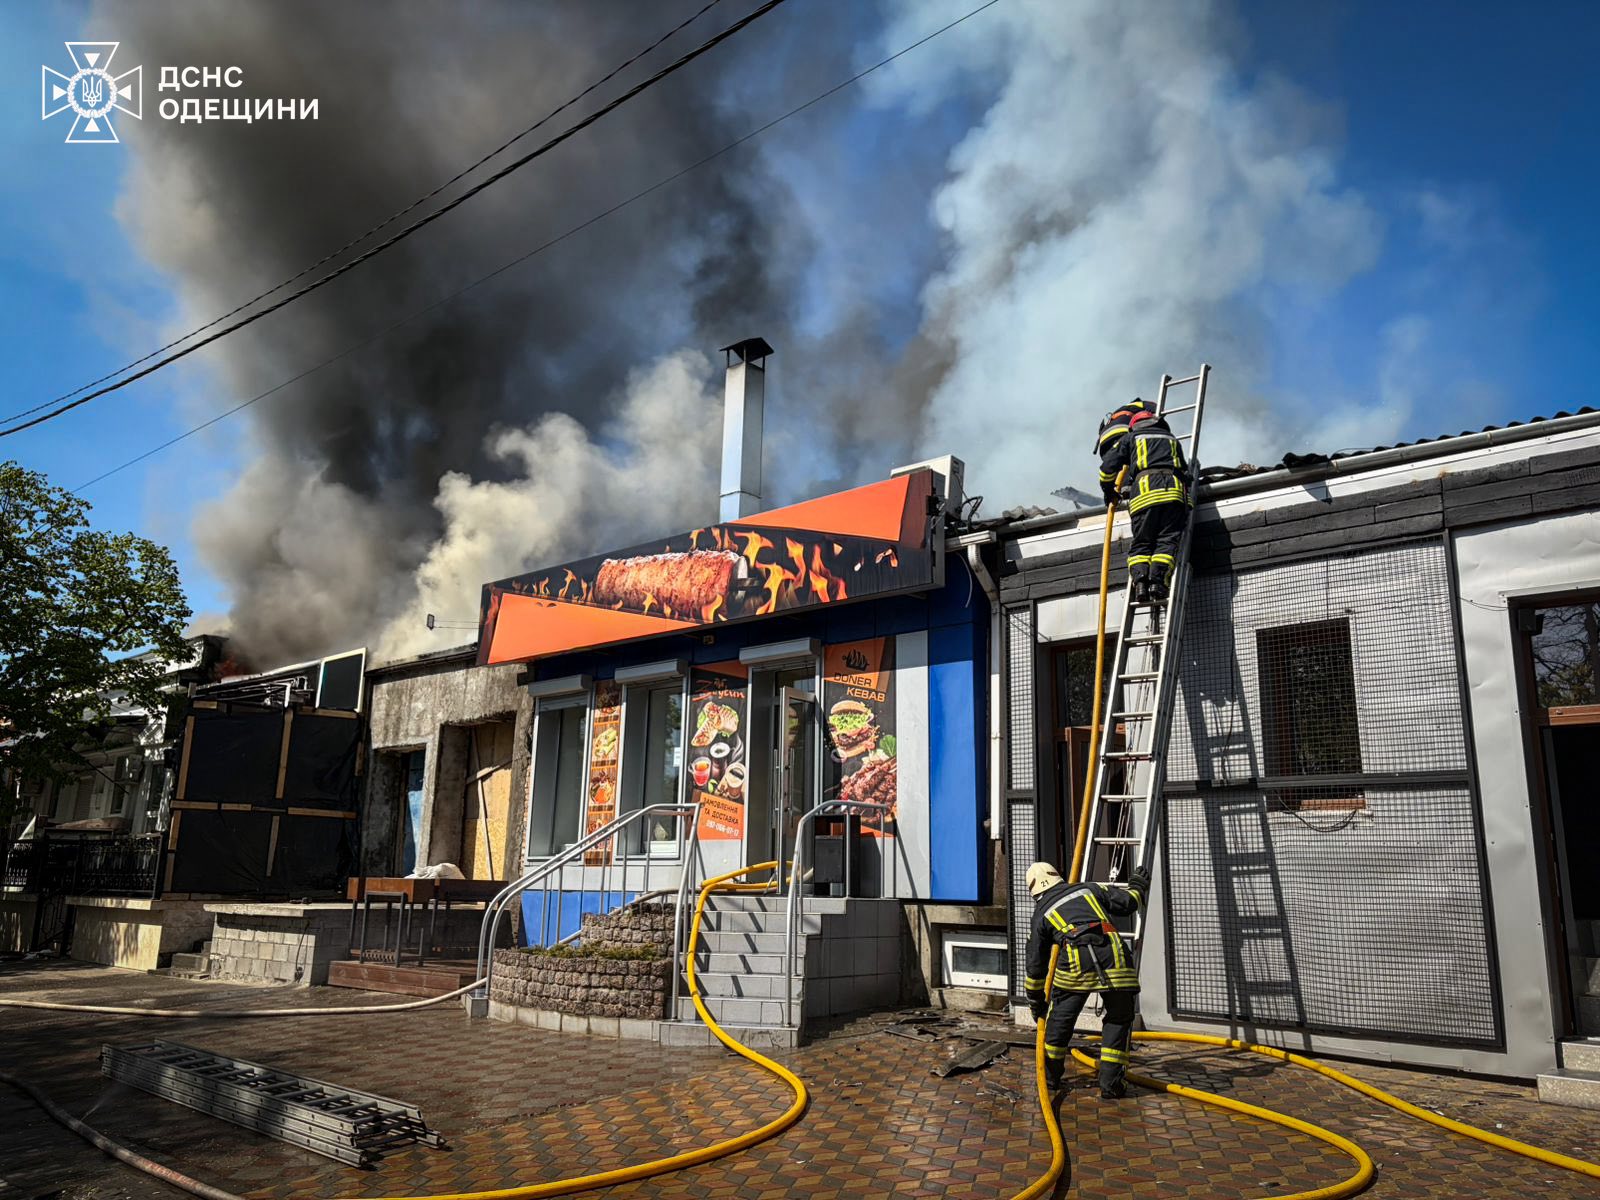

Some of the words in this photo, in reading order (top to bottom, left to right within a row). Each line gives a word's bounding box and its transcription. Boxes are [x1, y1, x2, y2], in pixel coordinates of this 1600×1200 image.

[833, 672, 872, 687] DONER
[846, 686, 886, 703] KEBAB
[711, 810, 739, 825] ДОСТАВКА
[1041, 879, 1050, 887] 21
